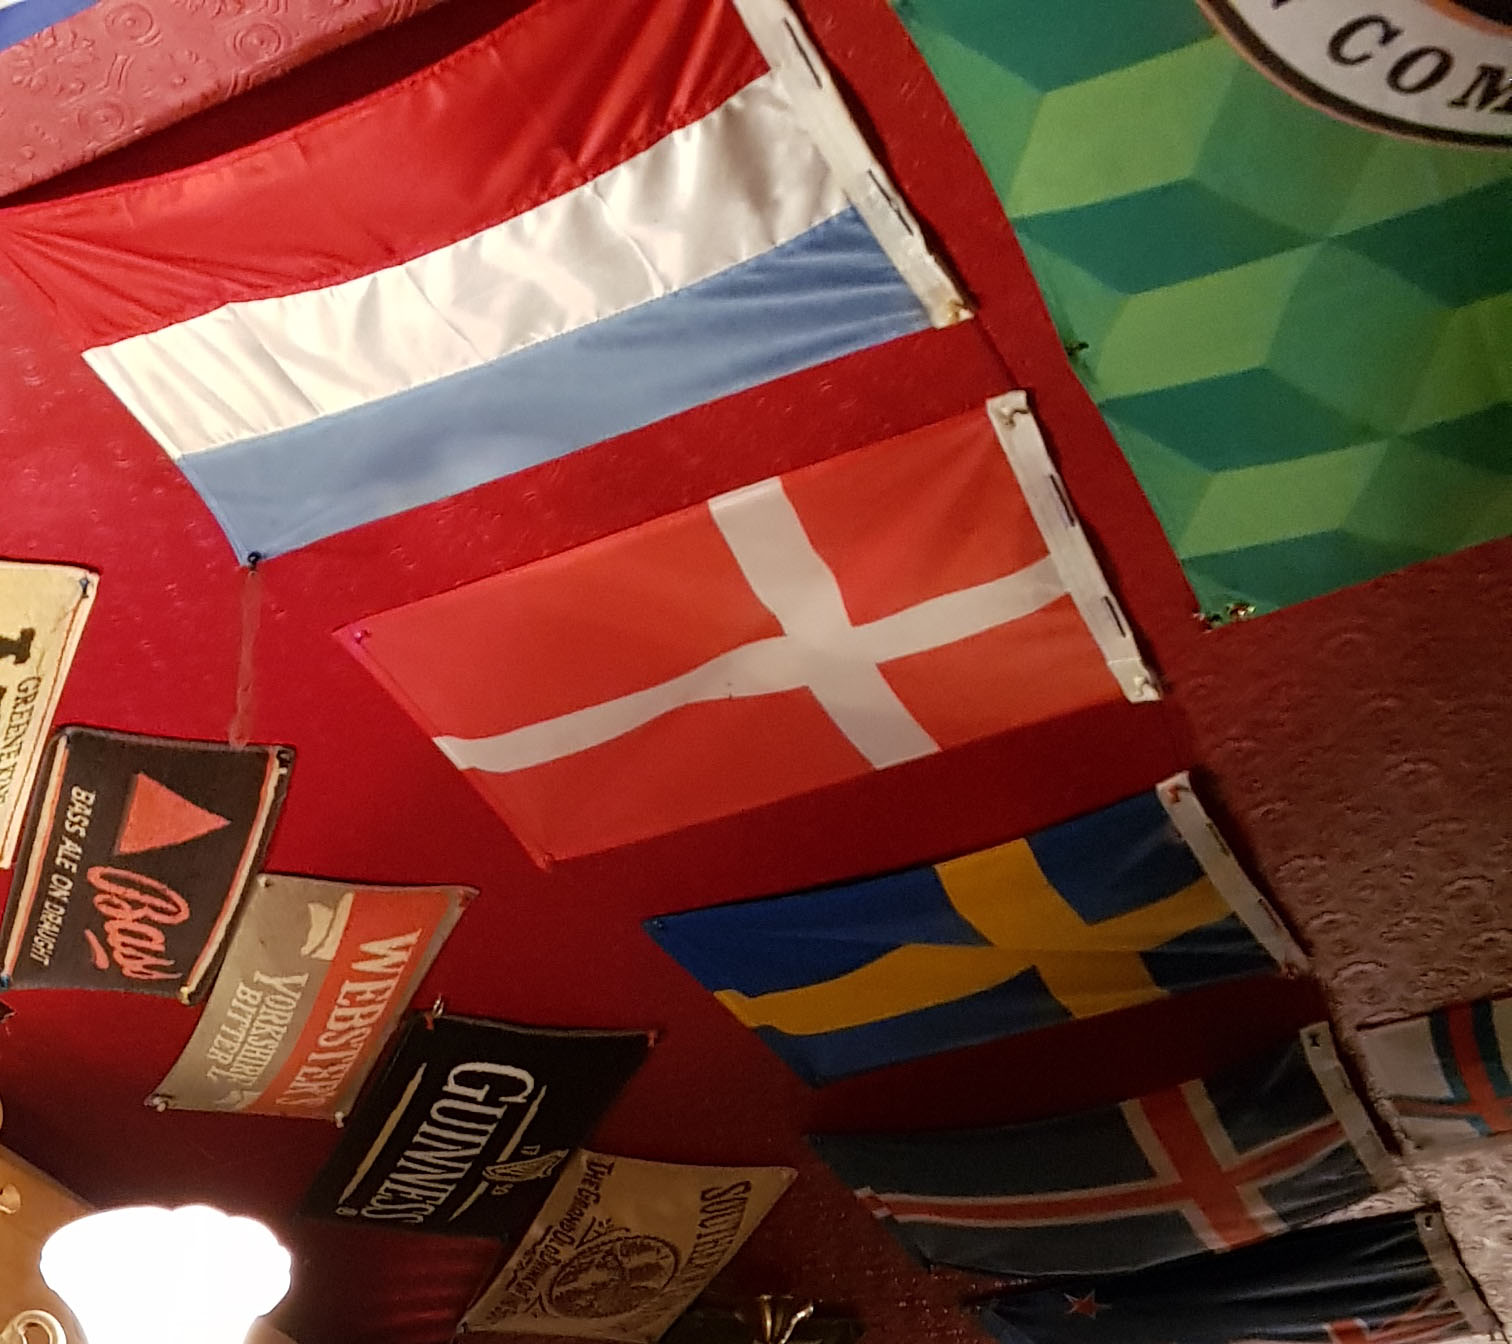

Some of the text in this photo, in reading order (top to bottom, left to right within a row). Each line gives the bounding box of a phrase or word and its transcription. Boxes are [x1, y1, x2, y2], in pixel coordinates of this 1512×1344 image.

[29, 785, 97, 967] BASS ALE ON DRAUGHT
[84, 865, 191, 980] Bass
[206, 981, 264, 1065] BITTER
[207, 969, 310, 1087] YORKSHIRE
[360, 1061, 535, 1224] GUINNESS
